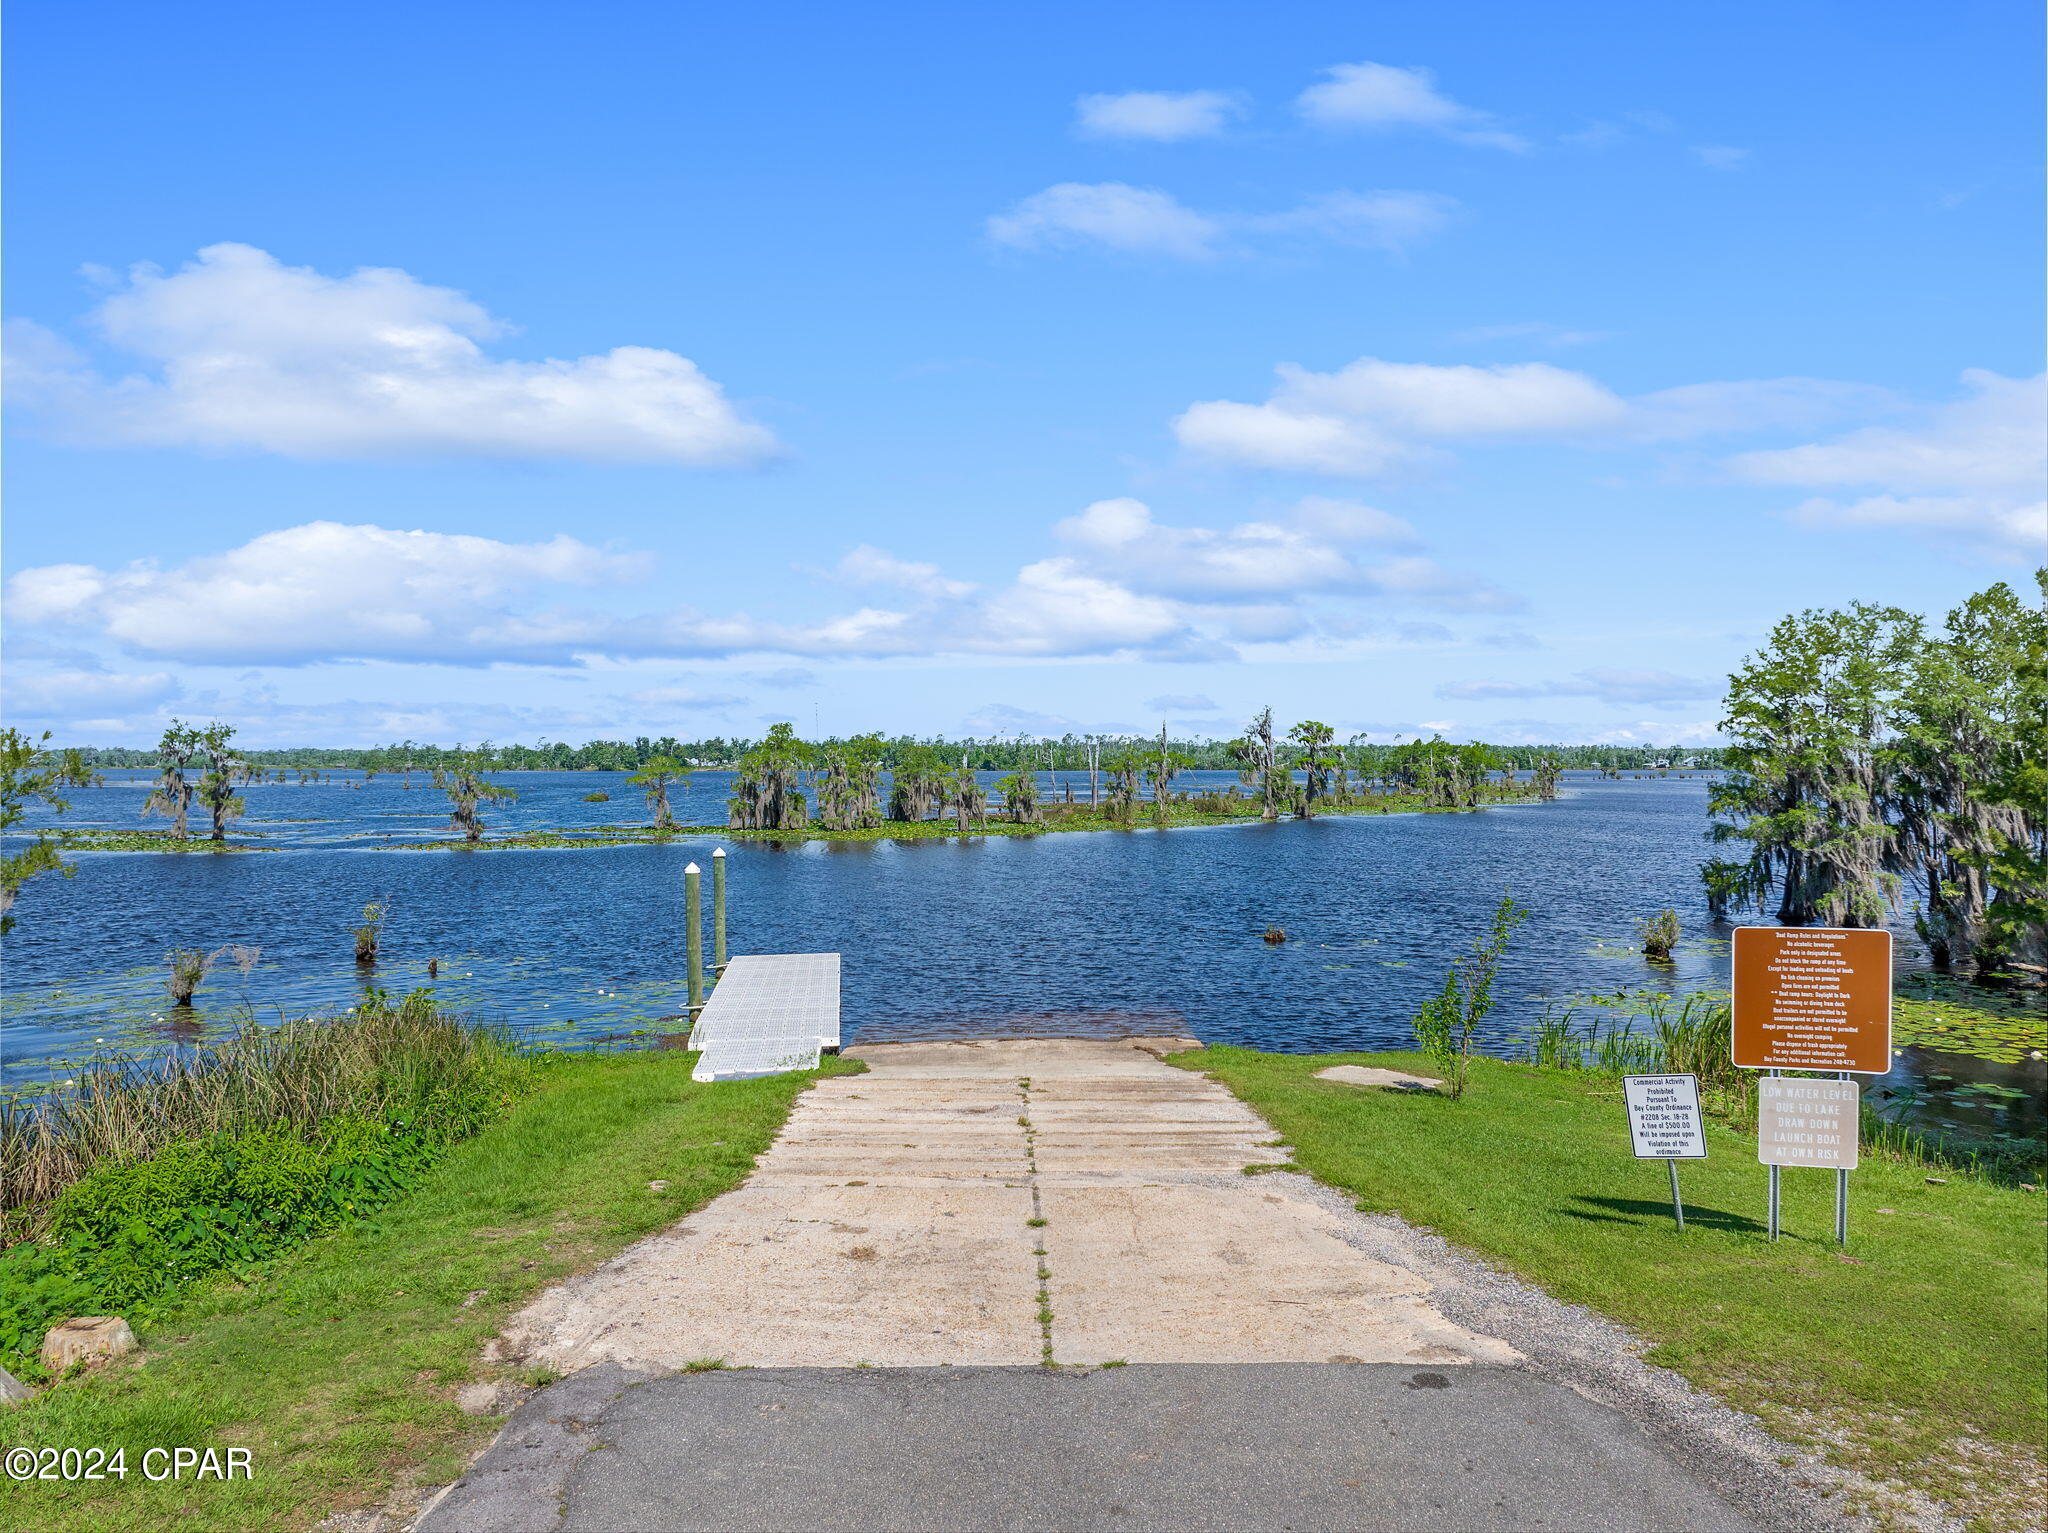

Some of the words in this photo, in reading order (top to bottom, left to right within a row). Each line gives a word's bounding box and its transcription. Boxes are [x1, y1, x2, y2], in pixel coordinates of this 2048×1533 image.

[1764, 1088, 1781, 1097] LOW
[1787, 1089, 1818, 1099] WATER
[1824, 1090, 1855, 1100] LEVEL
[1776, 1103, 1795, 1112] DUE
[1799, 1103, 1810, 1113] TO
[1815, 1104, 1840, 1115] LAKE
[1778, 1118, 1805, 1128] DRAW
[1810, 1119, 1838, 1129] DOWN
[1774, 1132, 1813, 1143] LAUNCH
[1817, 1135, 1840, 1144] BOAT
[1776, 1147, 1787, 1157] AT
[1792, 1148, 1813, 1158] OWN
[1818, 1149, 1839, 1159] RISK
